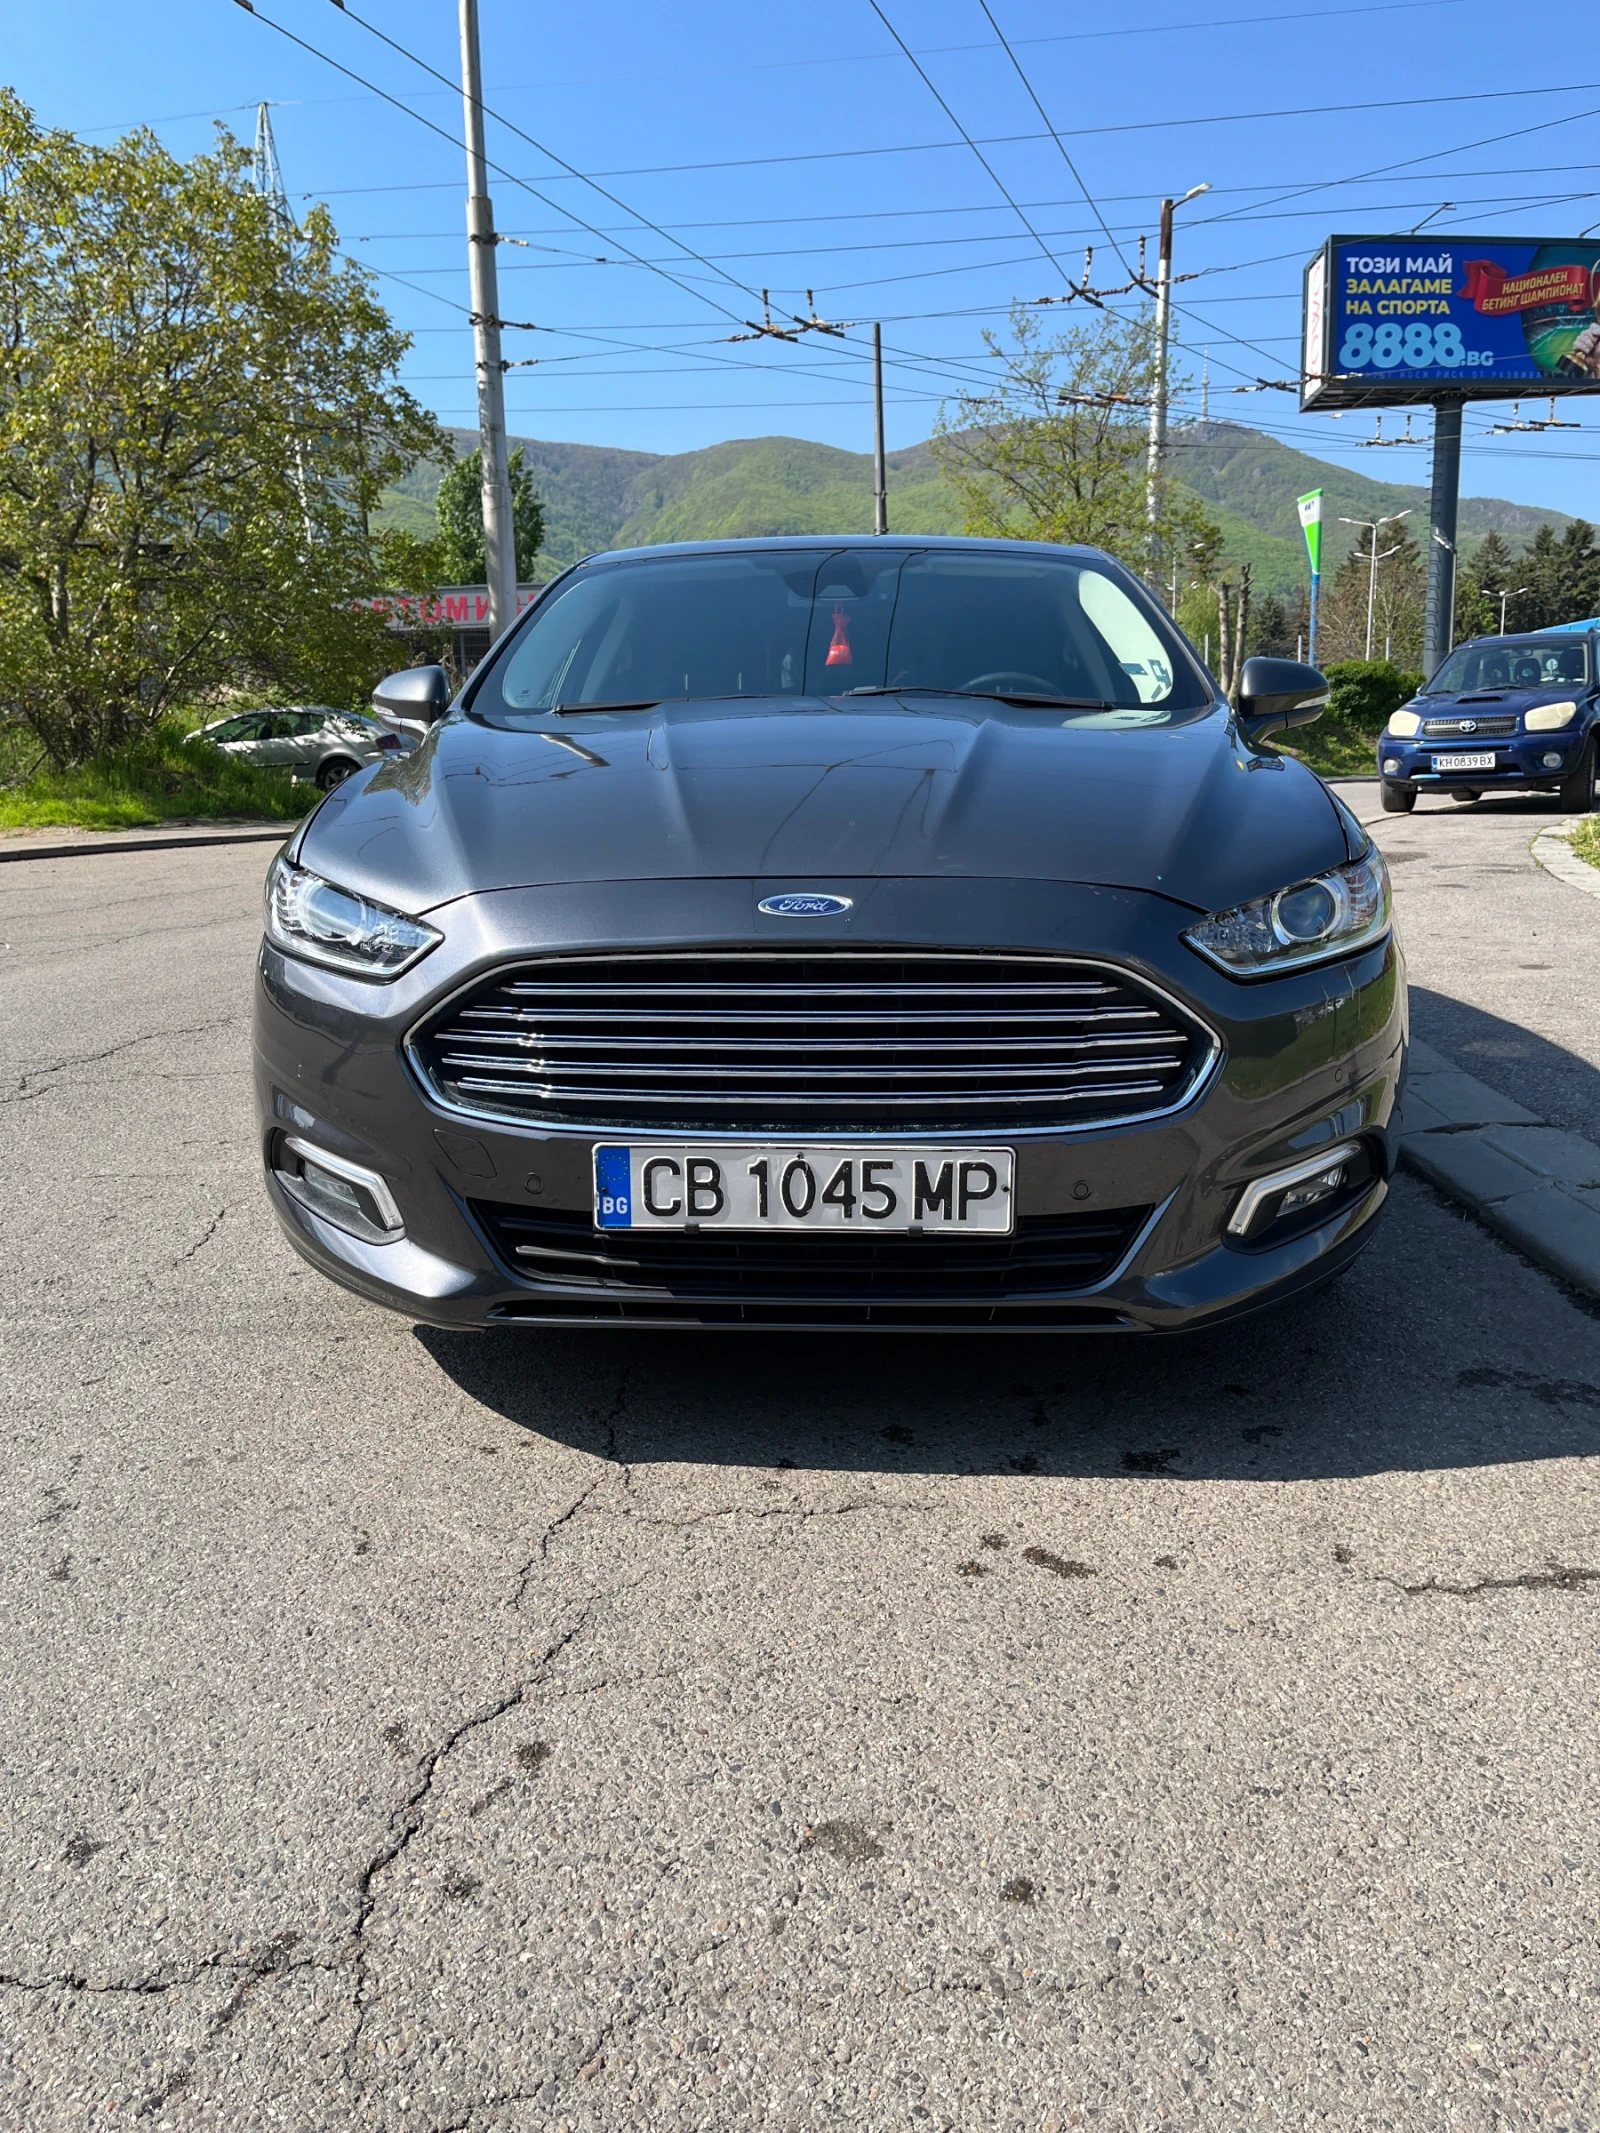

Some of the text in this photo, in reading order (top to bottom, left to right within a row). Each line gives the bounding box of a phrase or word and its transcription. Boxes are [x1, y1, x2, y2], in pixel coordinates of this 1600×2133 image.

[1347, 254, 1453, 273] ТОЗИ МАЙ
[1346, 279, 1453, 294] ЗАЛАГАМЕ
[1502, 271, 1568, 295] НАЦИОНАЛЕН
[1482, 283, 1584, 310] БЕТИНГ ШАМПИОНАТ
[1346, 300, 1451, 315] НА СПОРТА
[778, 897, 830, 912] Ford
[643, 1156, 998, 1220] CB 1045 MP
[602, 1195, 629, 1216] BG
